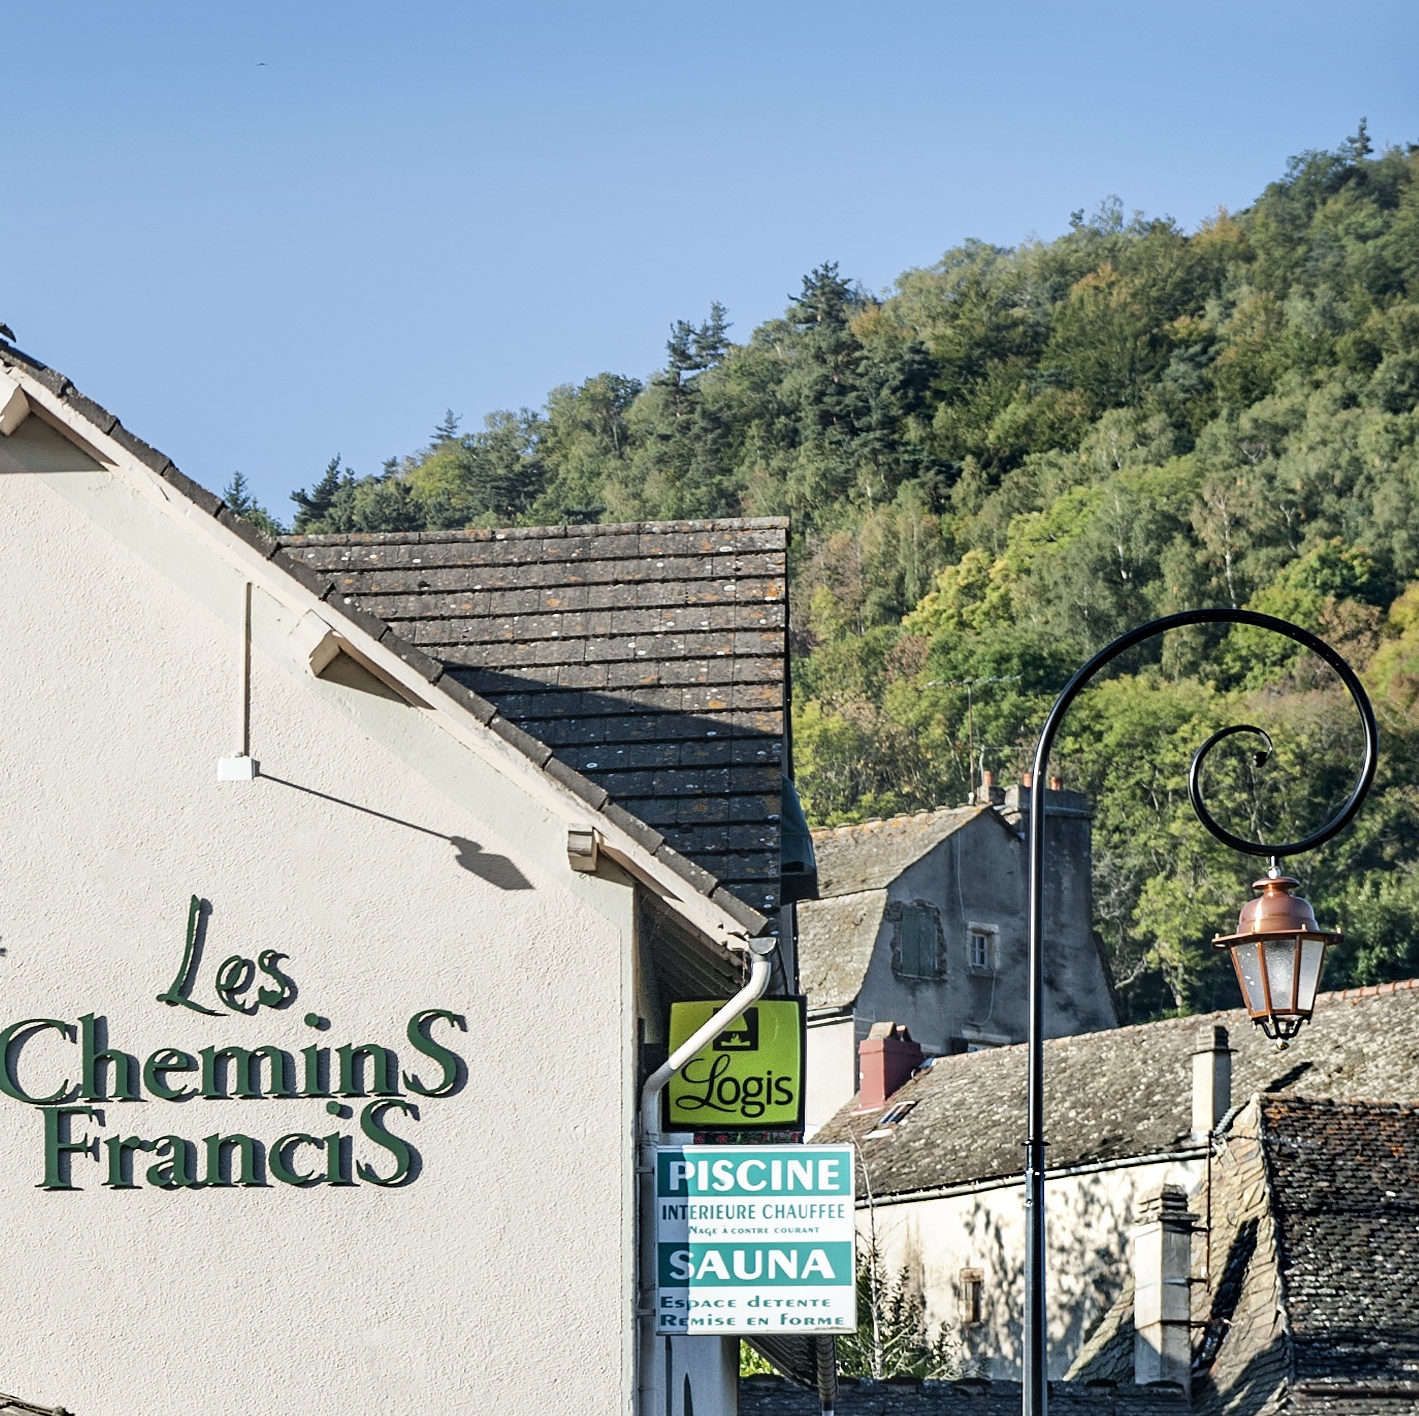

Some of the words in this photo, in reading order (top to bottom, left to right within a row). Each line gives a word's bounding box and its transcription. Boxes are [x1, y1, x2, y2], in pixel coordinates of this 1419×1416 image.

[156, 894, 290, 1016] Les
[676, 1054, 794, 1118] Logis
[669, 1159, 840, 1192] PISCINE
[662, 1203, 756, 1221] INTERIEURE
[762, 1203, 845, 1220] CHAUFFEE
[669, 1249, 836, 1281] SAUNA
